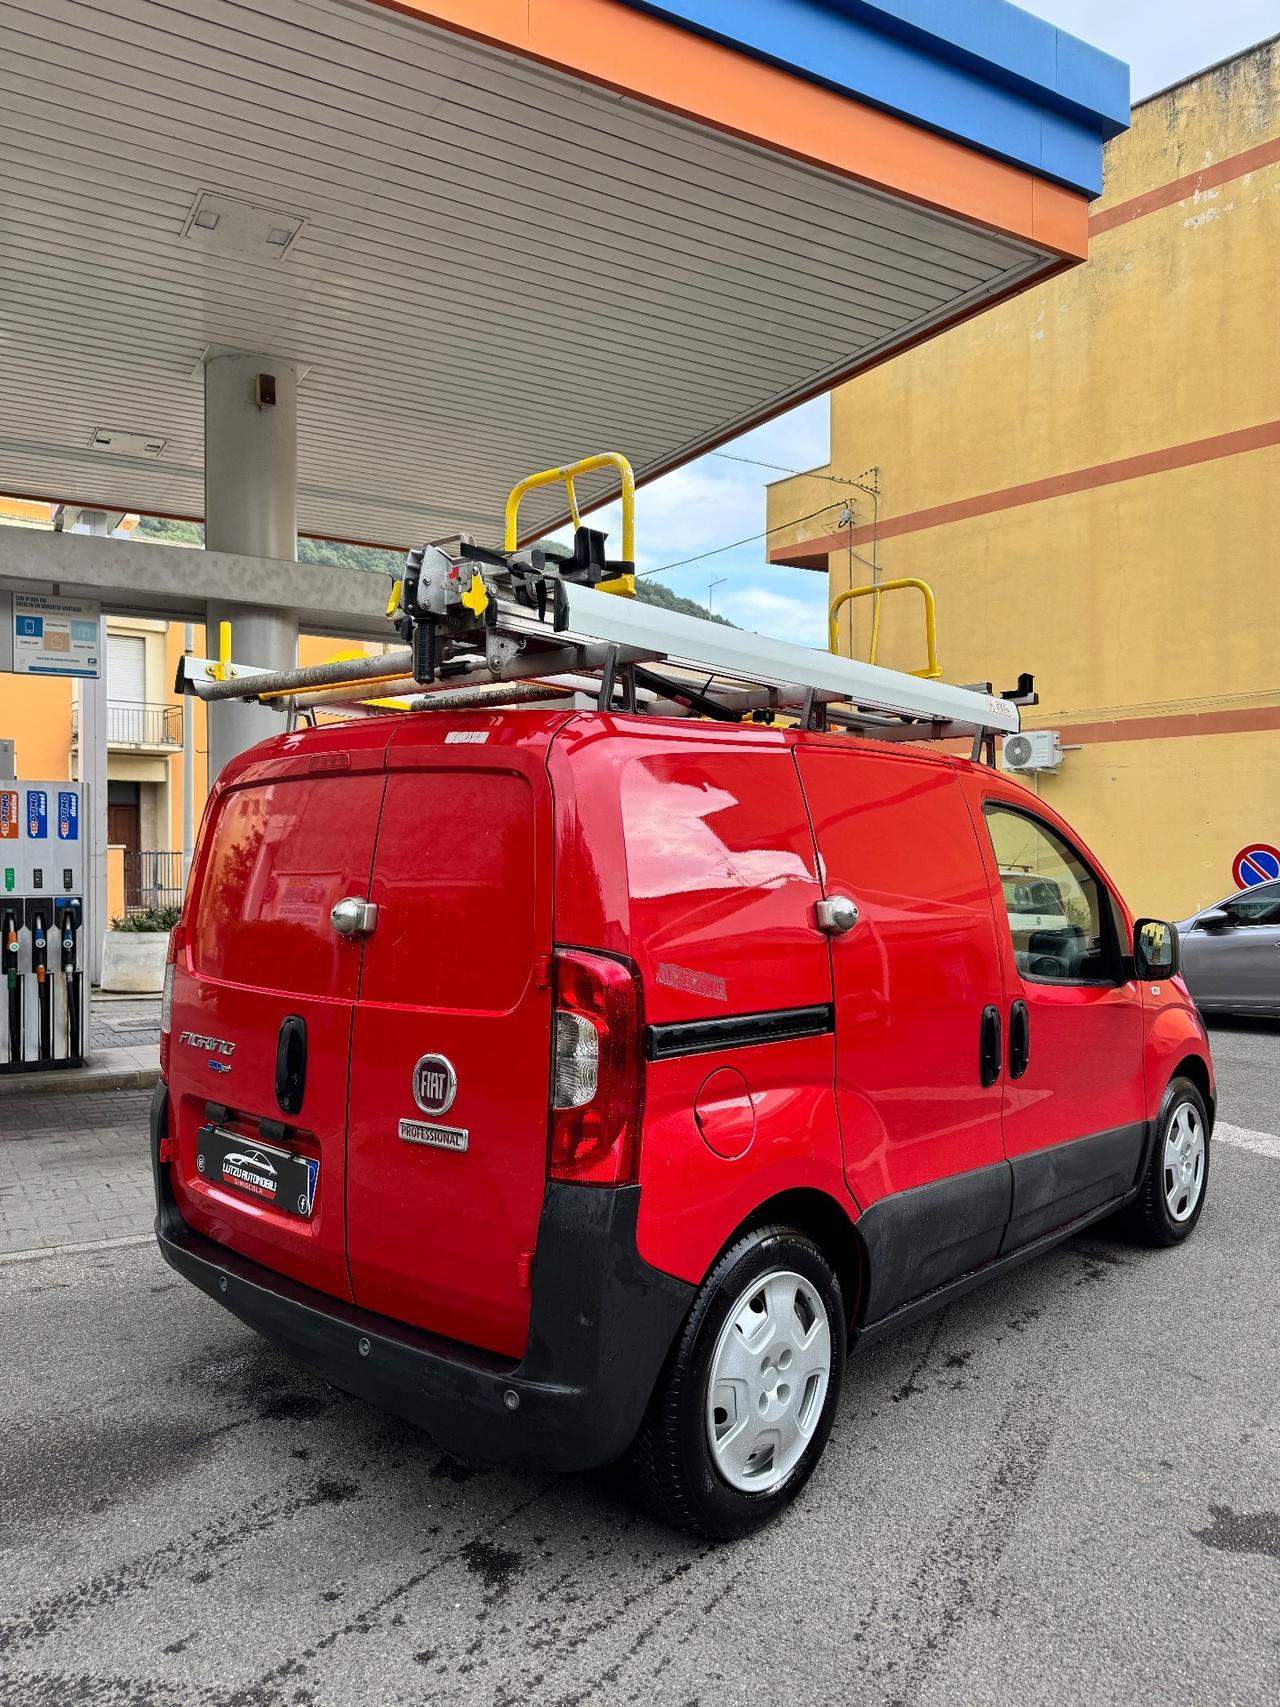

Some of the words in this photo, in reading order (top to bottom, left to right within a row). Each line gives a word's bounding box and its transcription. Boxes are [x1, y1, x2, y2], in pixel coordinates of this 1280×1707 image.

[178, 1031, 236, 1056] FIORINO
[420, 1070, 446, 1100] FIAT
[400, 1124, 460, 1147] PROFESSIONAL
[222, 1162, 242, 1181] LUTZU
[241, 1169, 278, 1192] AUTOMOBILI
